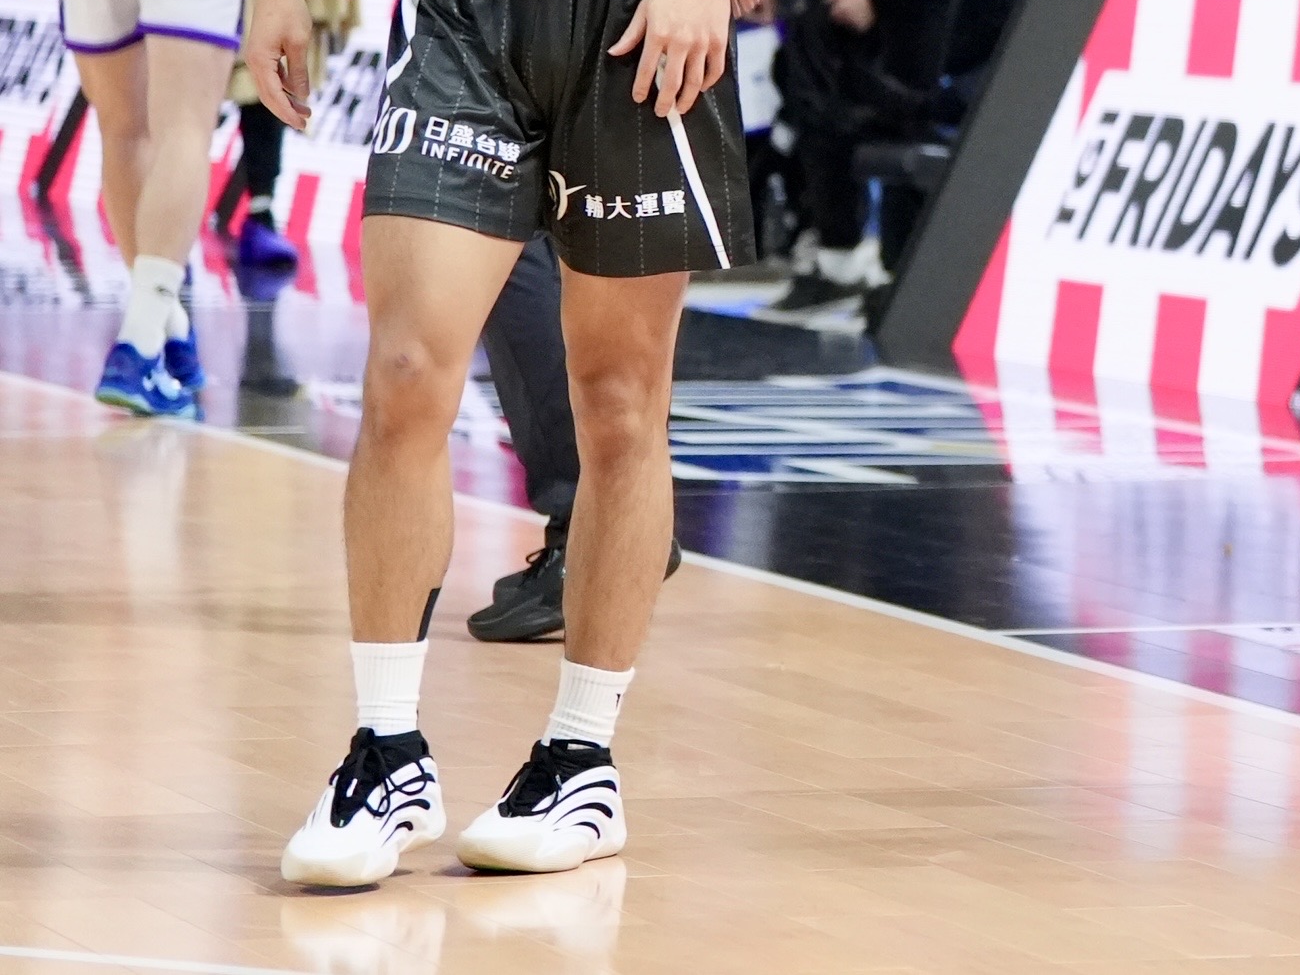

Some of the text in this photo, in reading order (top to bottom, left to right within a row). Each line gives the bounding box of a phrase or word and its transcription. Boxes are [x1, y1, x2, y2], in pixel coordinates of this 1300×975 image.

[424, 116, 522, 163] 日盛台駿
[421, 140, 515, 179] INFINITE
[585, 189, 686, 220] 輔大運醫
